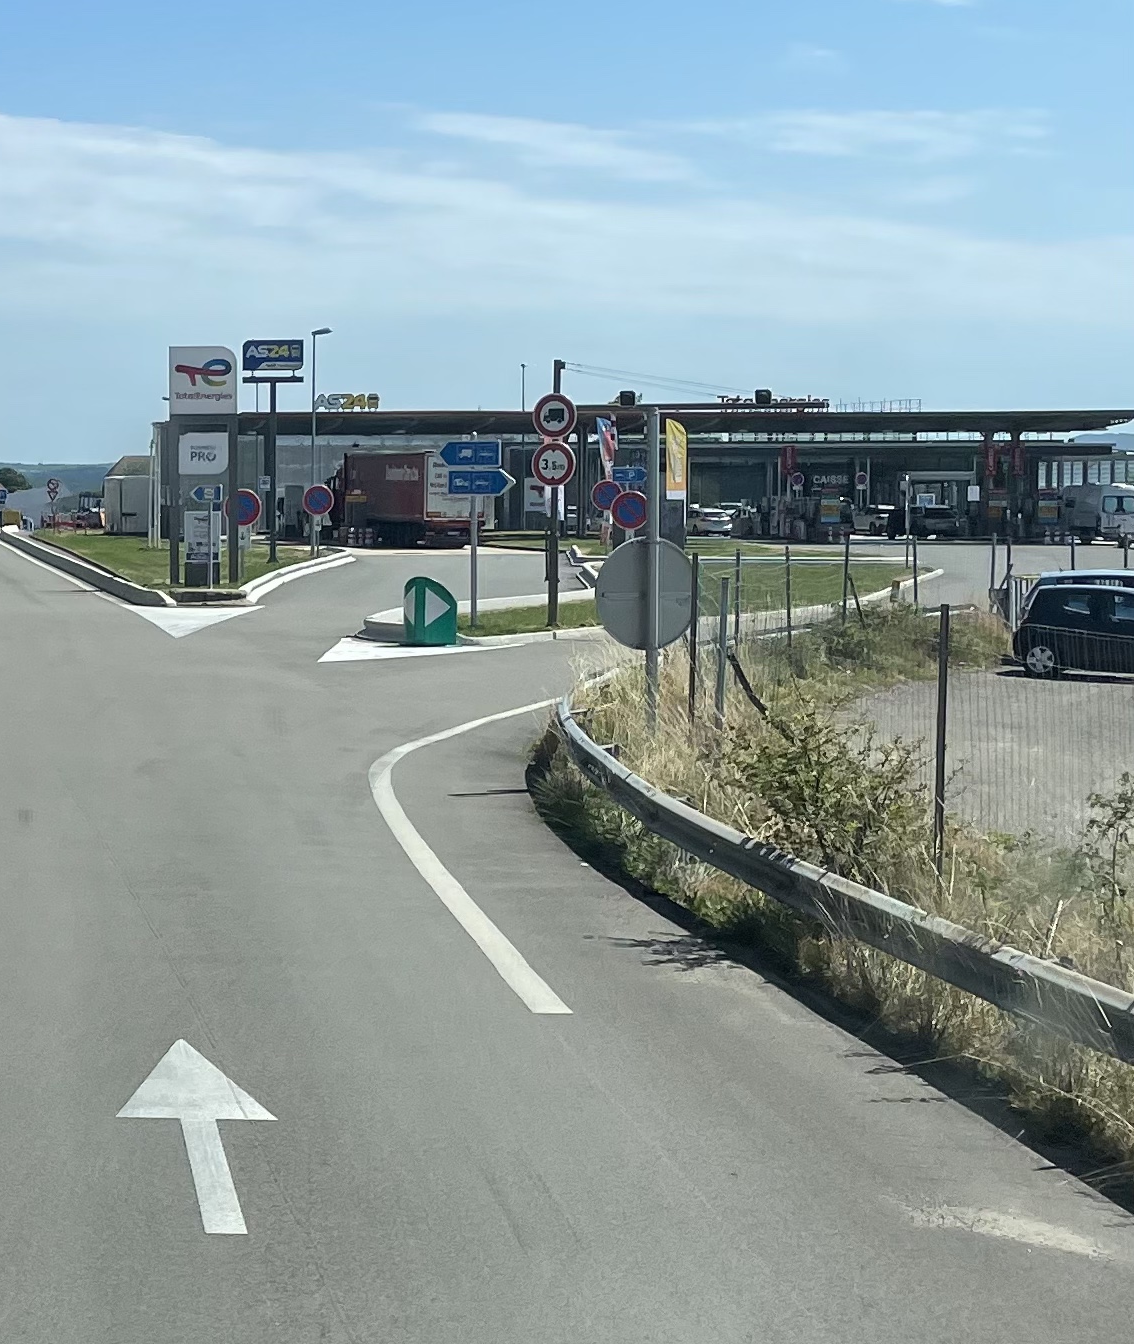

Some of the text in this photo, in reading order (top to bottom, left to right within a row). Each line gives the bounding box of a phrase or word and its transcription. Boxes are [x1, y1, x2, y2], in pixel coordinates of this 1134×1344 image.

[246, 345, 289, 358] AS24
[315, 394, 366, 410] AS24
[190, 451, 216, 462] PRO
